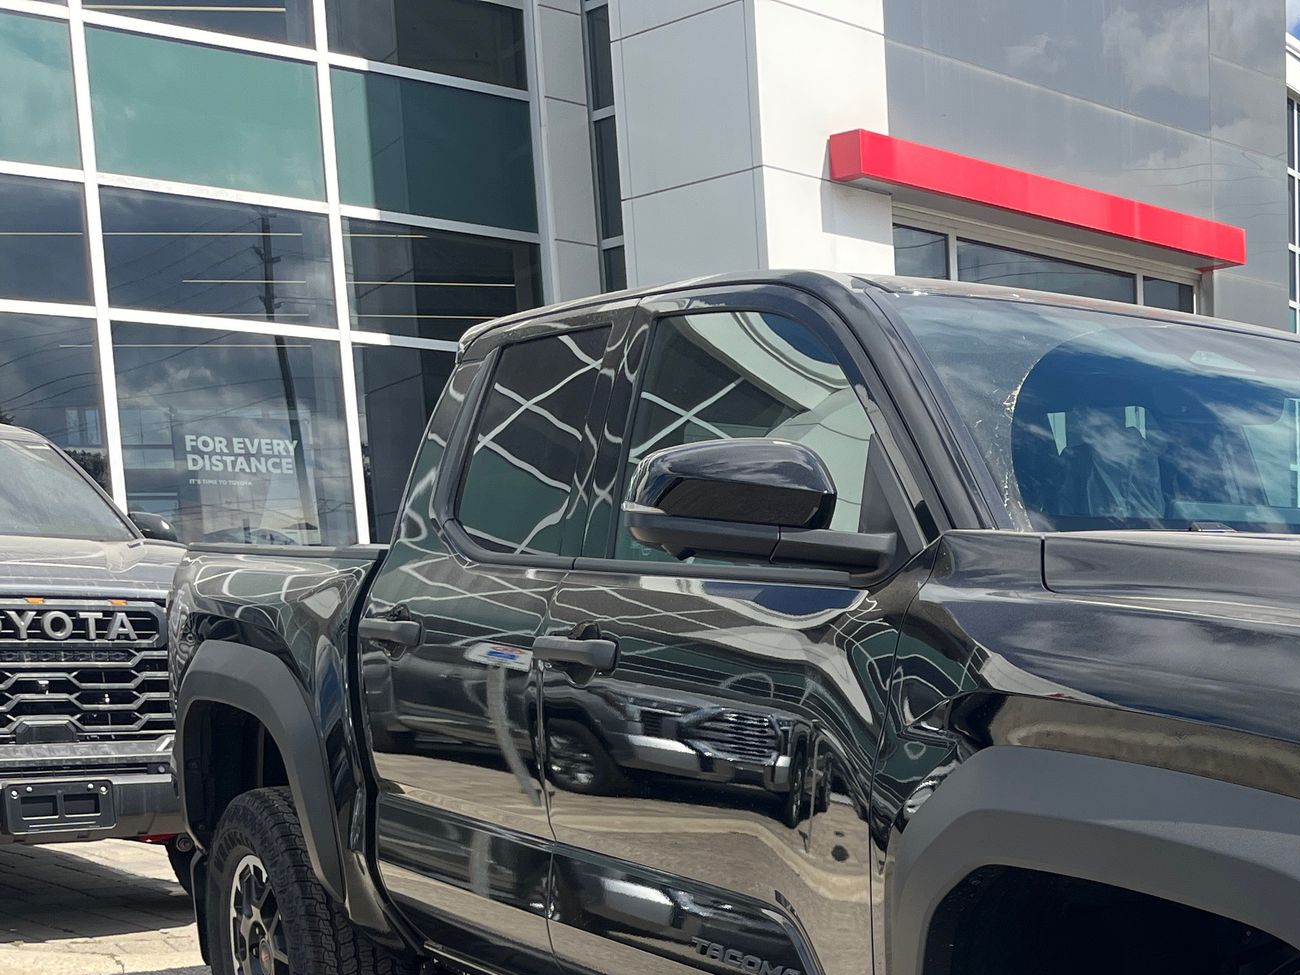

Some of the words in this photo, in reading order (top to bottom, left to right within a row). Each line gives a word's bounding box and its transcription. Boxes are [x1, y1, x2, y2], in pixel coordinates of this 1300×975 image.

[185, 435, 229, 453] FOR
[232, 437, 298, 456] EVERY
[186, 454, 293, 474] DISTANCE
[0, 611, 139, 641] YOTA
